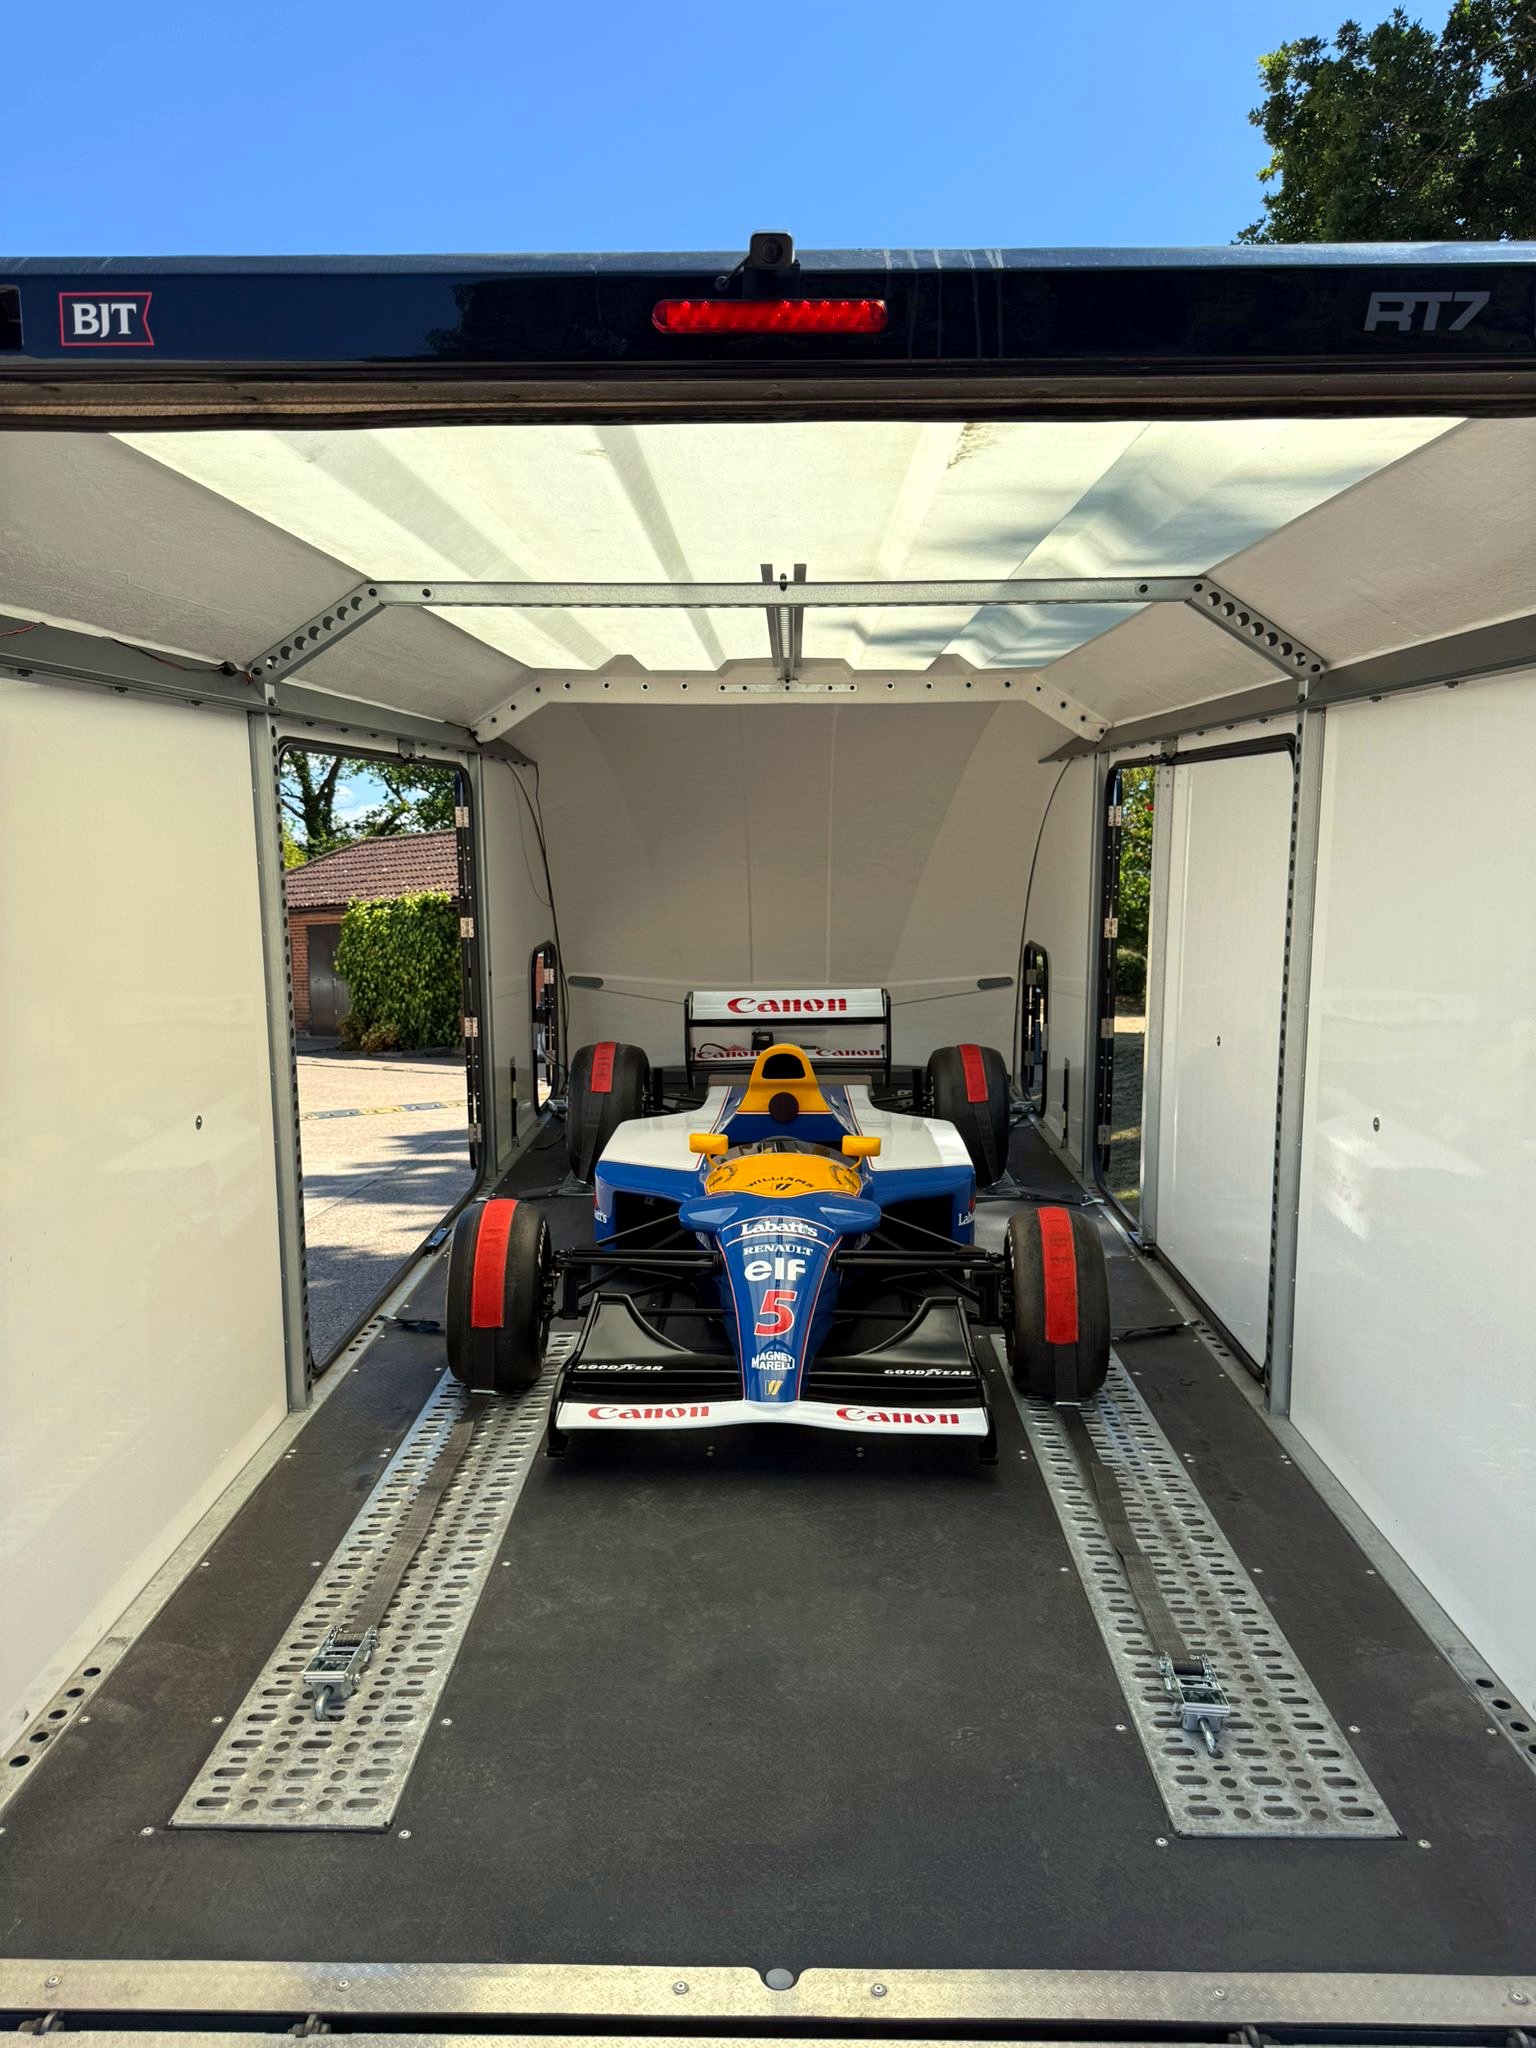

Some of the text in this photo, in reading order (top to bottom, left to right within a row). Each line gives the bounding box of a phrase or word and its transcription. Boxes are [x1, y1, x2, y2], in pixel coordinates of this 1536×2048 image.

[1363, 291, 1491, 332] RT7
[72, 303, 137, 338] BJT
[727, 997, 847, 1014] Canon
[697, 1050, 761, 1059] Canon
[815, 1049, 880, 1057] Canon
[745, 1176, 815, 1189] WILLIAMS
[740, 1220, 818, 1237] Labatt's
[743, 1244, 814, 1256] RENAULT
[744, 1257, 806, 1282] elf
[754, 1289, 798, 1337] 5
[577, 1363, 664, 1371] GOODYEAR
[884, 1368, 972, 1377] GOODYEAR
[588, 1405, 709, 1420] Canon
[836, 1407, 960, 1424] Canon
